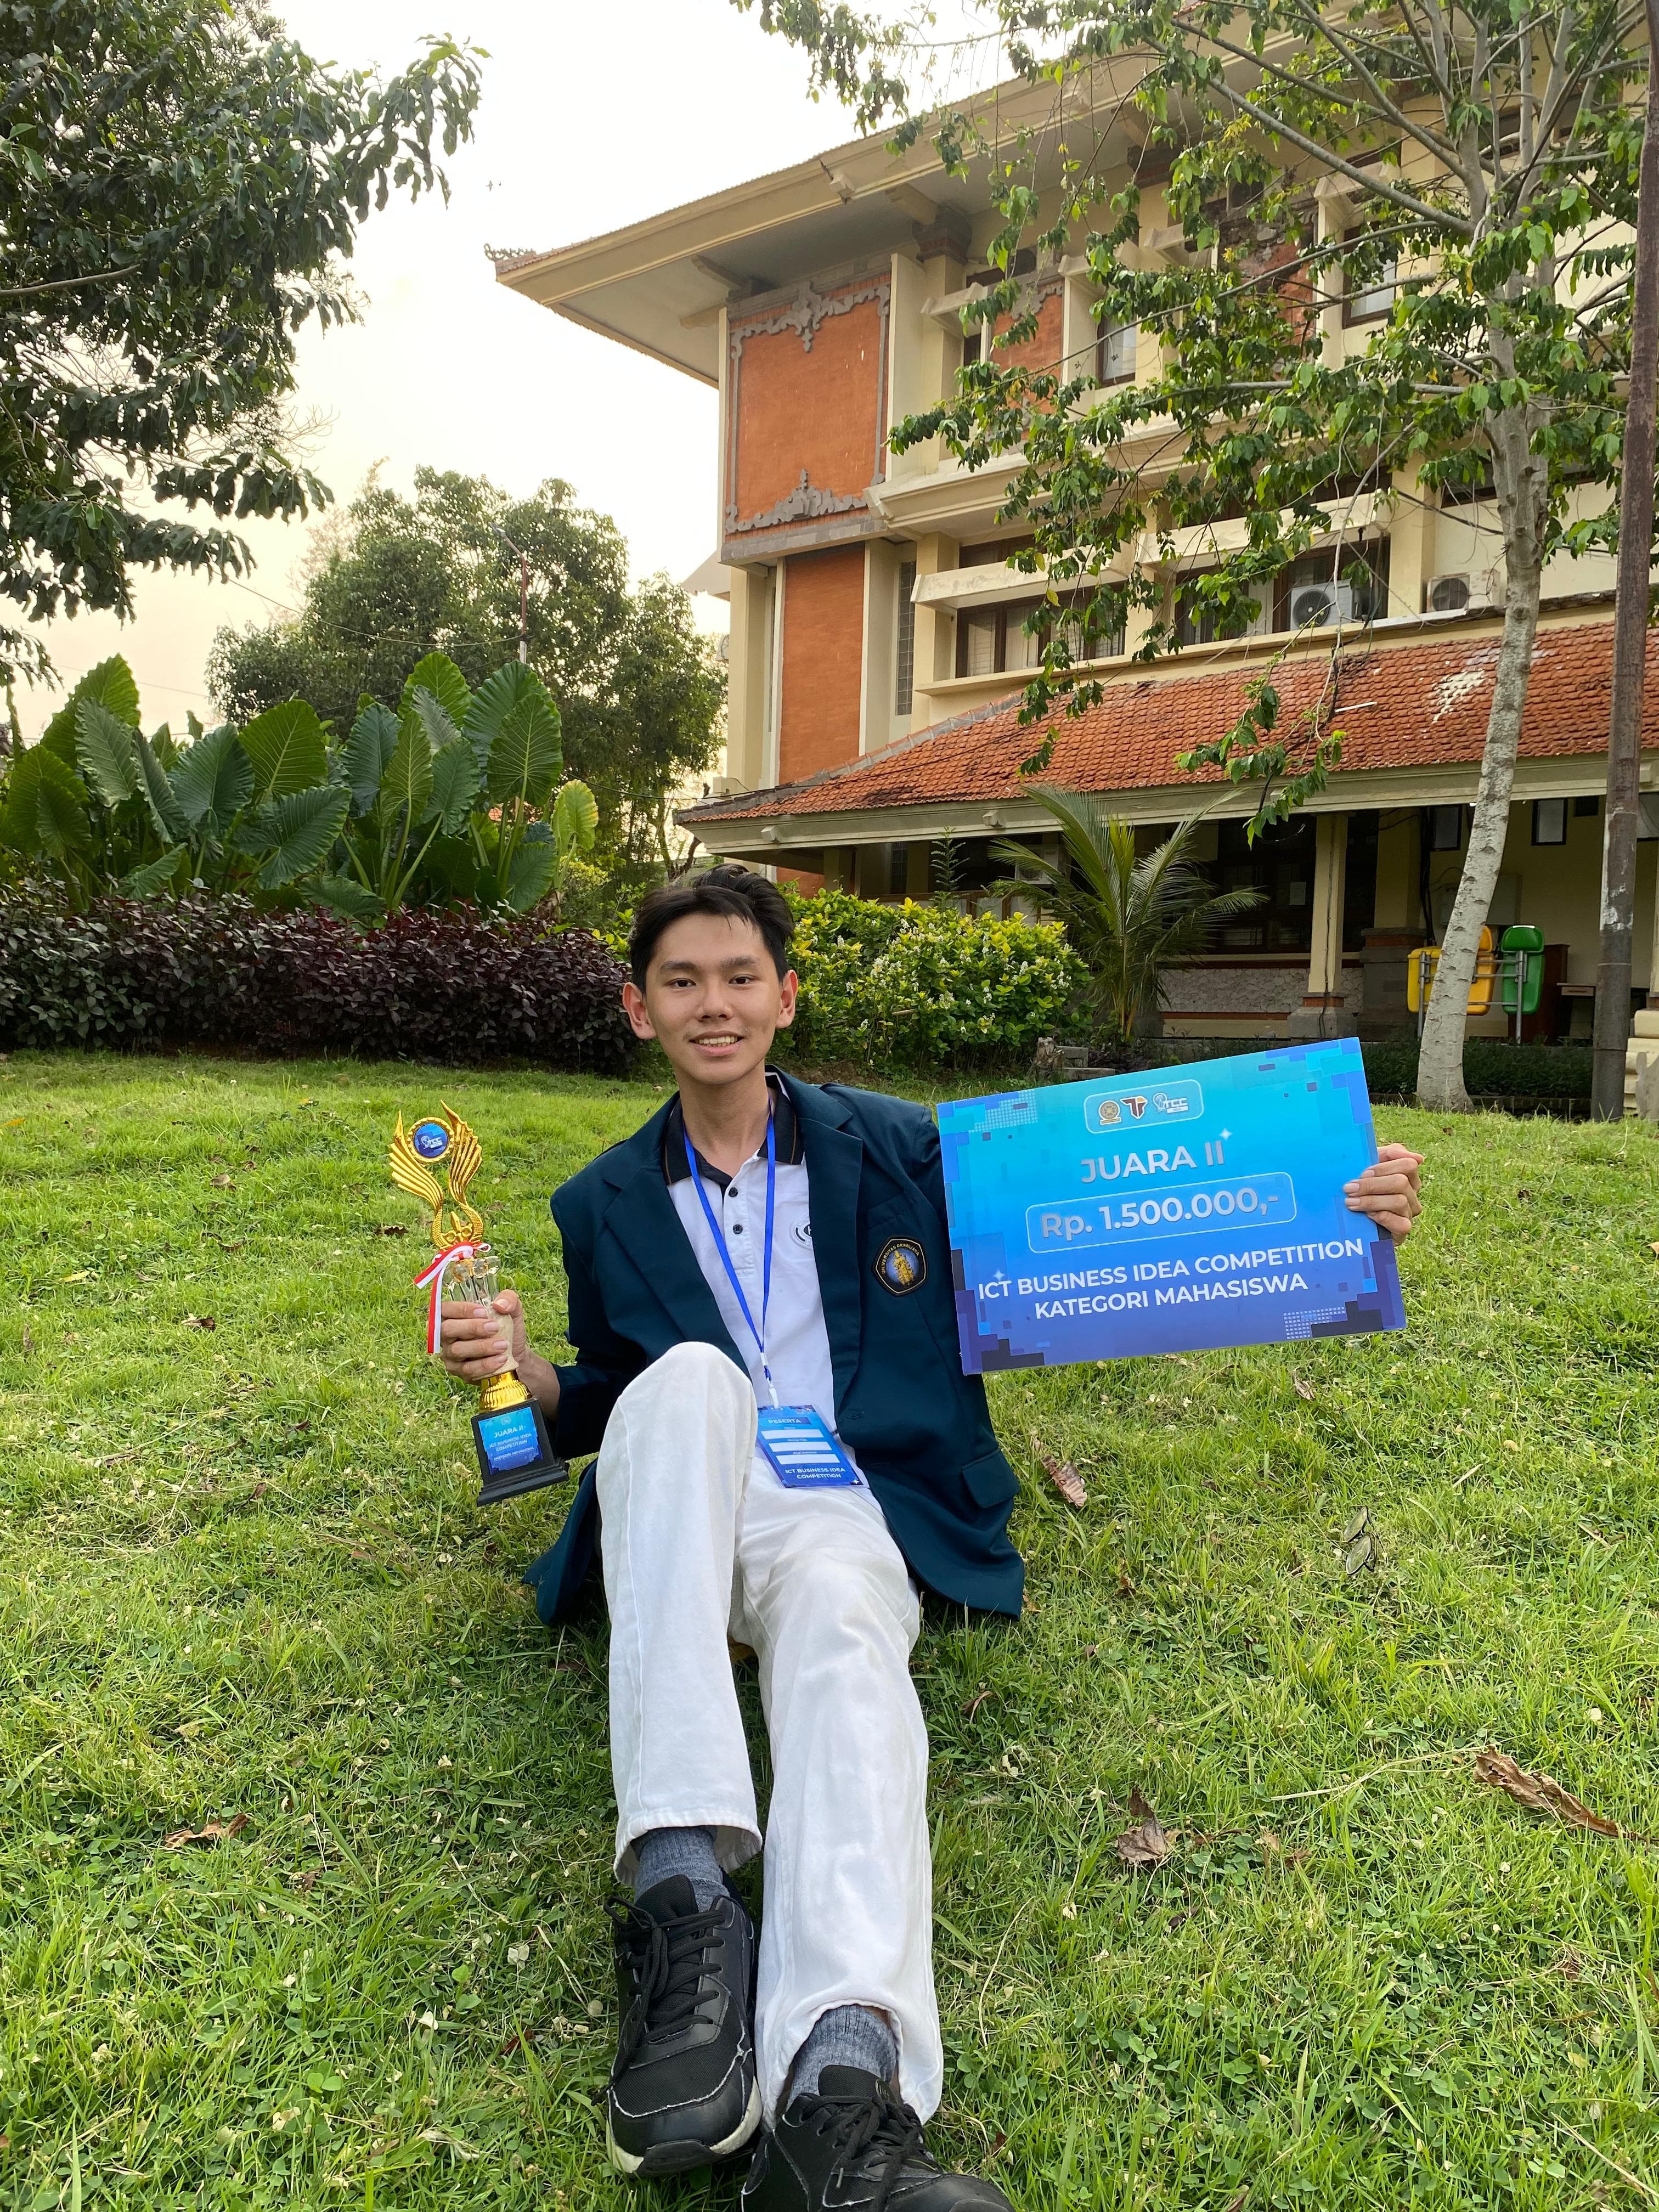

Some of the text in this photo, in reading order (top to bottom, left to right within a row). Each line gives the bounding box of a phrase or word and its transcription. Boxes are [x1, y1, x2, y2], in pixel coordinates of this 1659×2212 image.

[1080, 1140, 1225, 1183] JUARA II
[1041, 1187, 1279, 1242] Rp. 1.500.000,-
[978, 1238, 1364, 1300] ICT BUSINESS IDEA COMPETITION
[1035, 1273, 1309, 1319] KATEGORI MAHASISWA
[494, 1427, 518, 1438] JUARA
[496, 1439, 528, 1452] COMPETITION
[497, 1436, 520, 1446] BUSINESS
